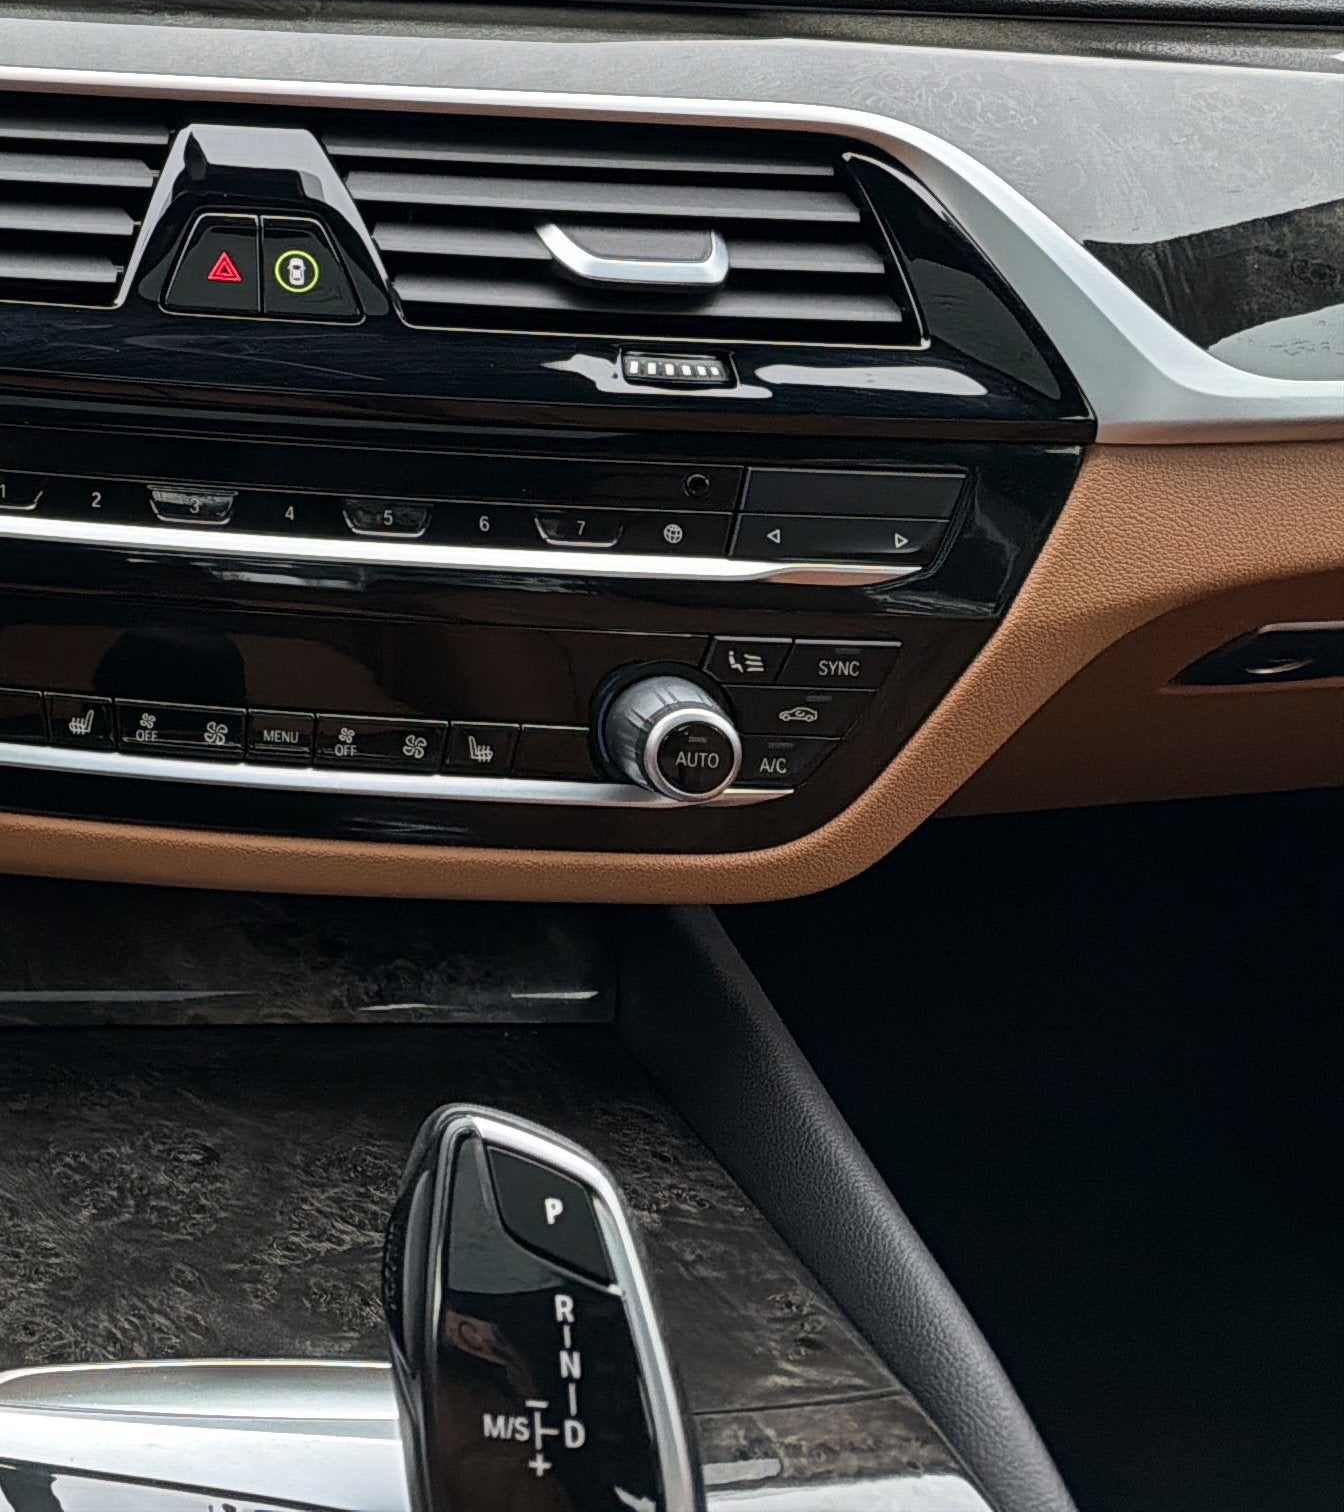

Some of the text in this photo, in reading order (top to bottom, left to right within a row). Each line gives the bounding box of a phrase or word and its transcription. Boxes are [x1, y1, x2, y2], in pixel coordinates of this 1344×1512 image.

[91, 491, 102, 508] 2
[189, 497, 200, 514] 3
[284, 505, 295, 521] 4
[383, 509, 394, 526] 5
[479, 515, 490, 532] 6
[576, 520, 587, 536] 7
[817, 660, 861, 677] SYNC
[135, 730, 159, 743] OFF
[262, 729, 300, 745] MENU
[334, 743, 358, 757] OFF
[675, 750, 720, 769] AUTO
[759, 757, 788, 775] A/C
[544, 1196, 564, 1225] P
[554, 1293, 574, 1324] R
[558, 1349, 582, 1380] N
[483, 1412, 586, 1449] M/S D
